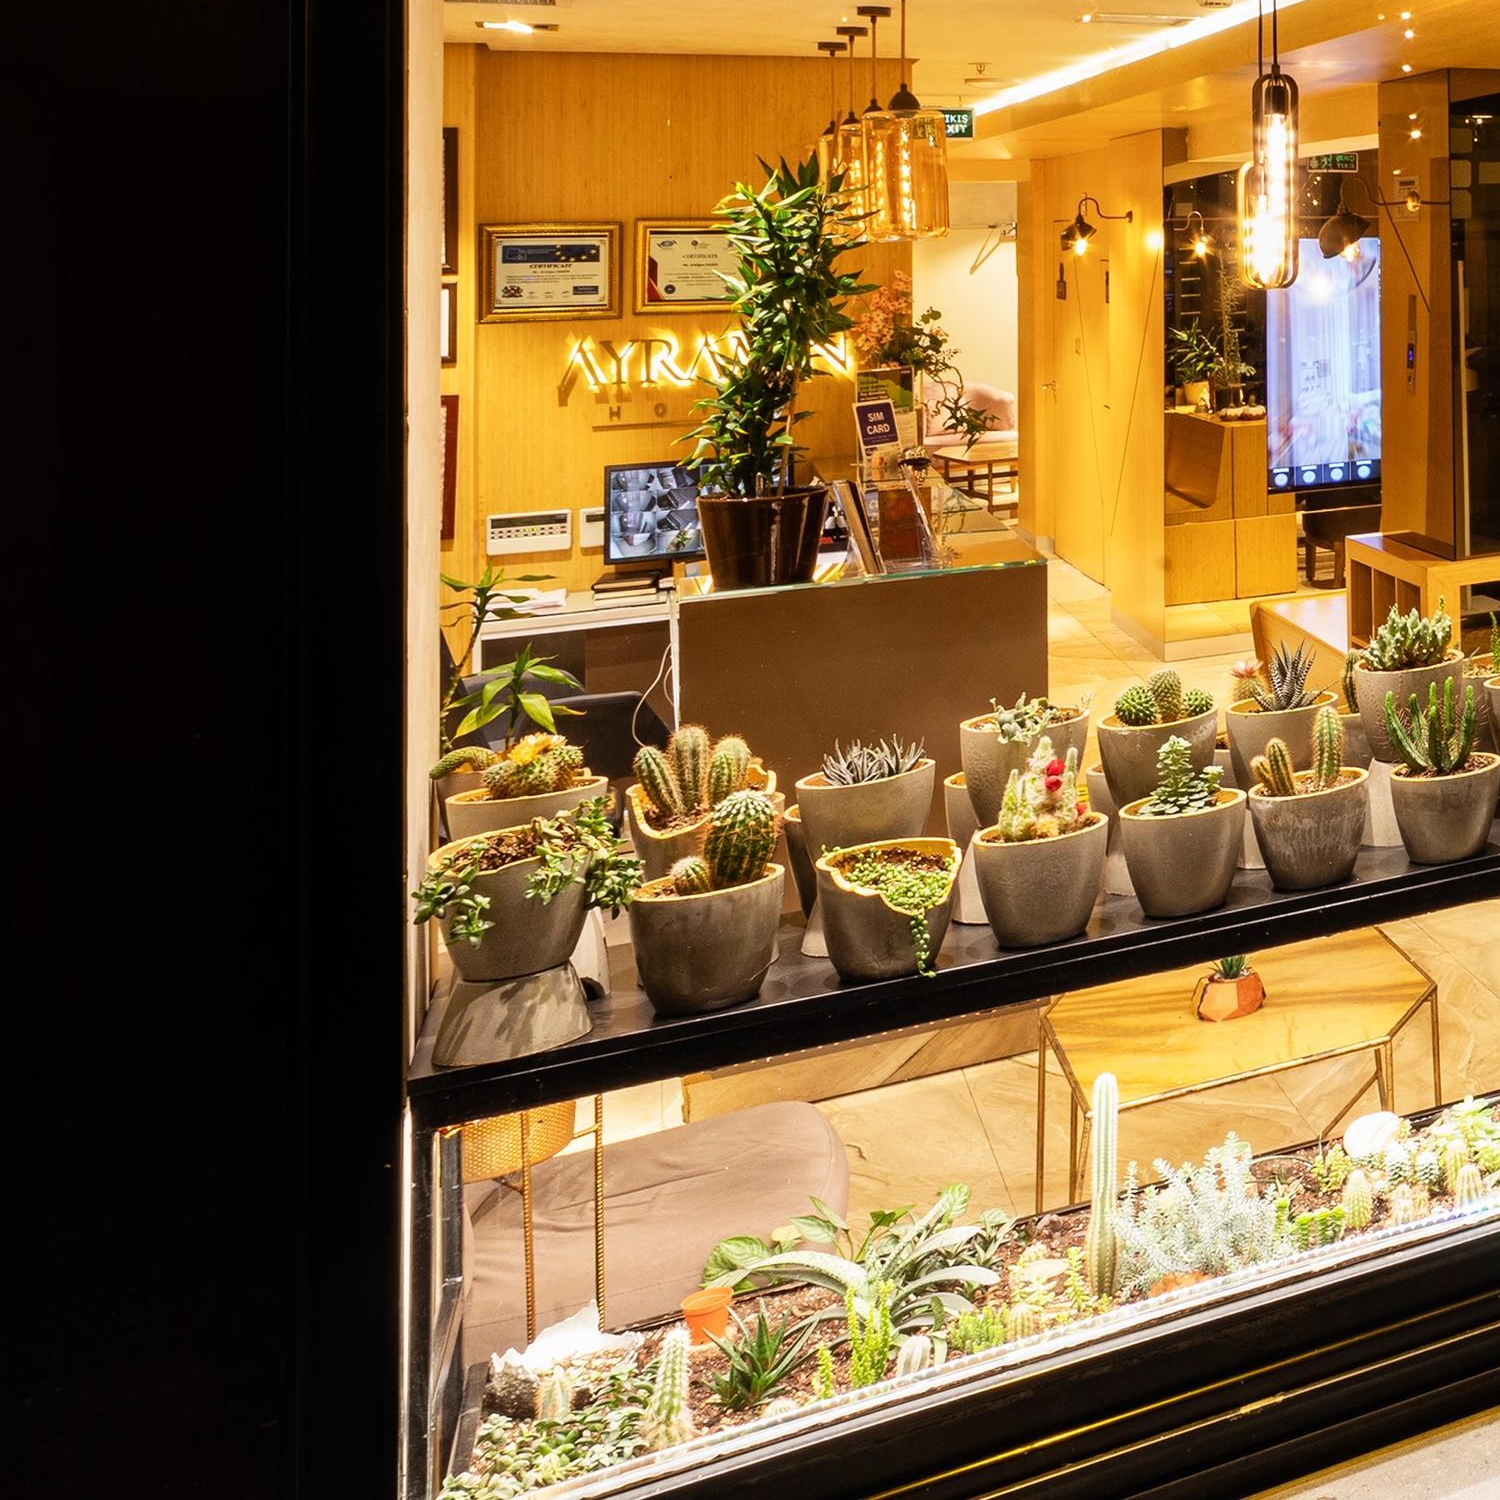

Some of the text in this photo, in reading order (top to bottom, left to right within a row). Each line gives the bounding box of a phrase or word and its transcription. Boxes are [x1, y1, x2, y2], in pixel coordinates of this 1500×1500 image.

[946, 124, 967, 134] XIT
[867, 411, 884, 422] SIM
[866, 423, 890, 435] CARD
